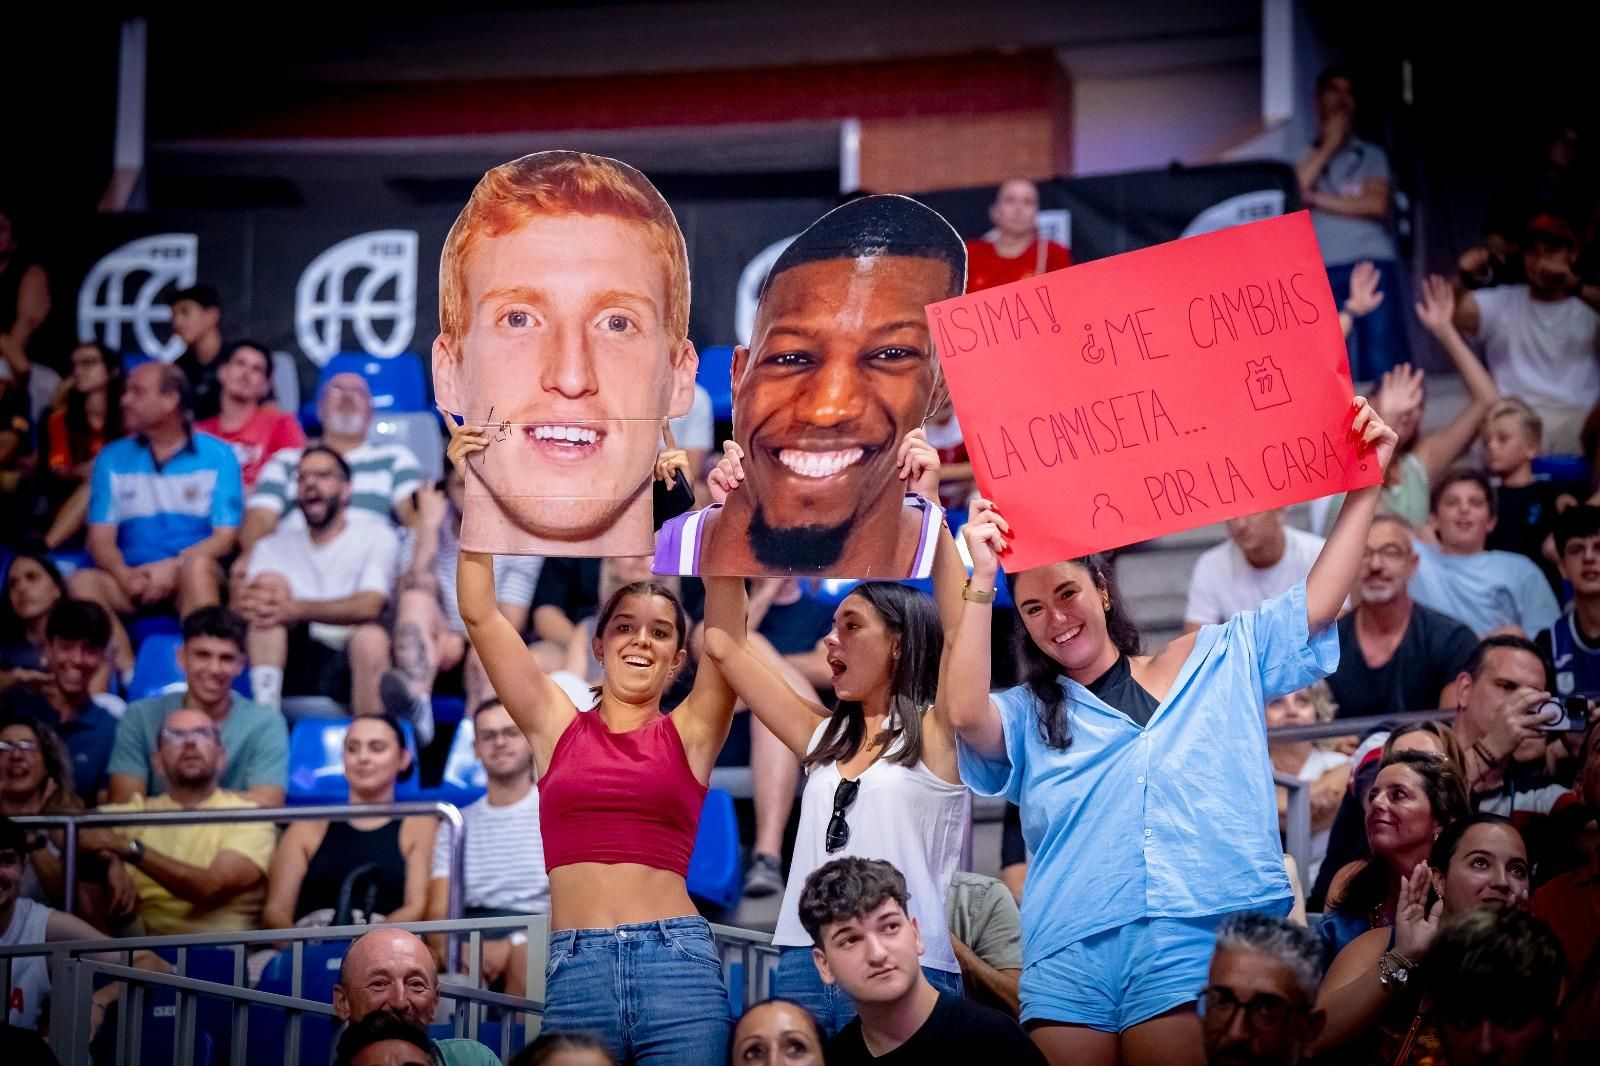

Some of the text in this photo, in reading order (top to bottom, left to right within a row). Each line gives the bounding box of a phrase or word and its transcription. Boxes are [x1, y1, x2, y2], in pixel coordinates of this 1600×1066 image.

[932, 285, 1061, 358] ¡SIMA!
[1081, 273, 1320, 366] ¿ME CAMBIAS
[977, 389, 1207, 480] LA CAMISETA...
[1143, 469, 1210, 520] POR
[1206, 456, 1255, 505] LA
